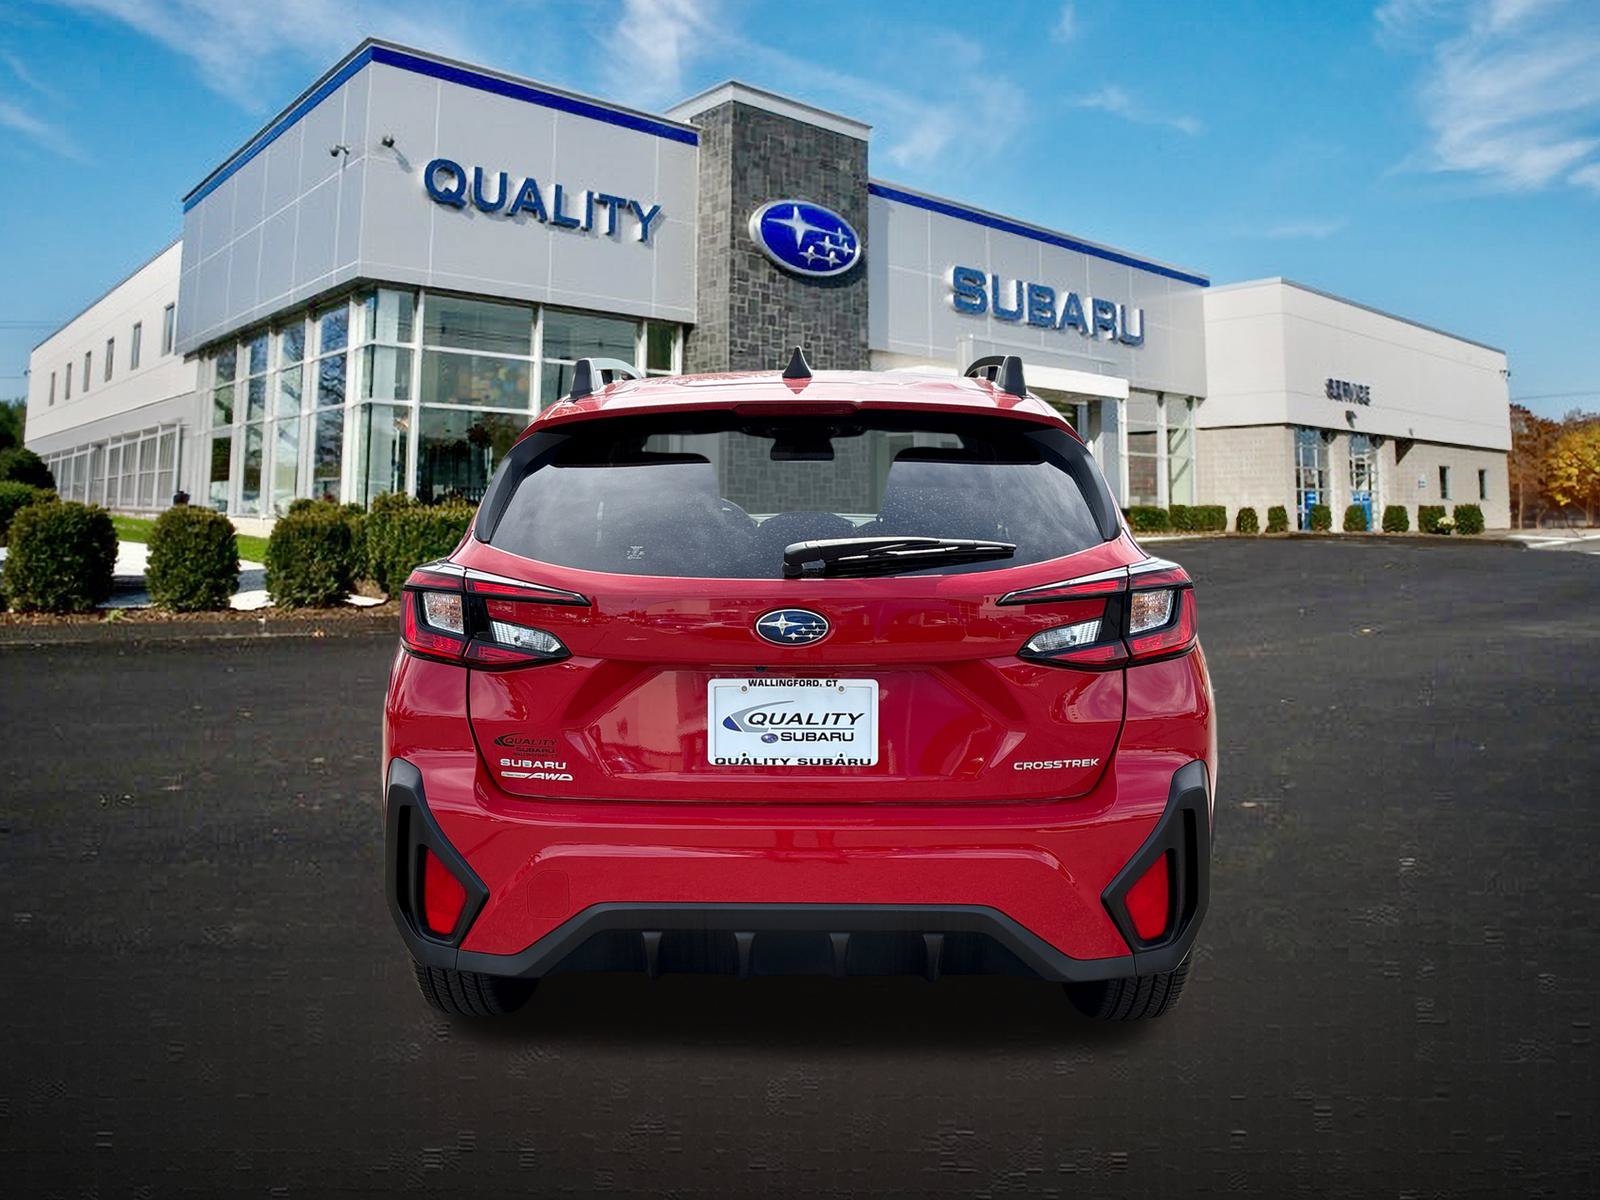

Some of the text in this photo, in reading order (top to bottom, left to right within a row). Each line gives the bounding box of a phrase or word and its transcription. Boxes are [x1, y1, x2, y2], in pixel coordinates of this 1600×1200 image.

[424, 158, 661, 242] QUALITY
[951, 265, 1145, 347] SUBARU
[825, 679, 838, 687] CT
[748, 712, 864, 726] QUALITY
[504, 737, 558, 746] QUALITY
[780, 732, 854, 742] SUBARU
[500, 758, 567, 770] SUBARU
[714, 757, 872, 766] QUALITY SUBARU
[1013, 758, 1100, 771] CROSSTREK
[528, 772, 574, 782] AWD
